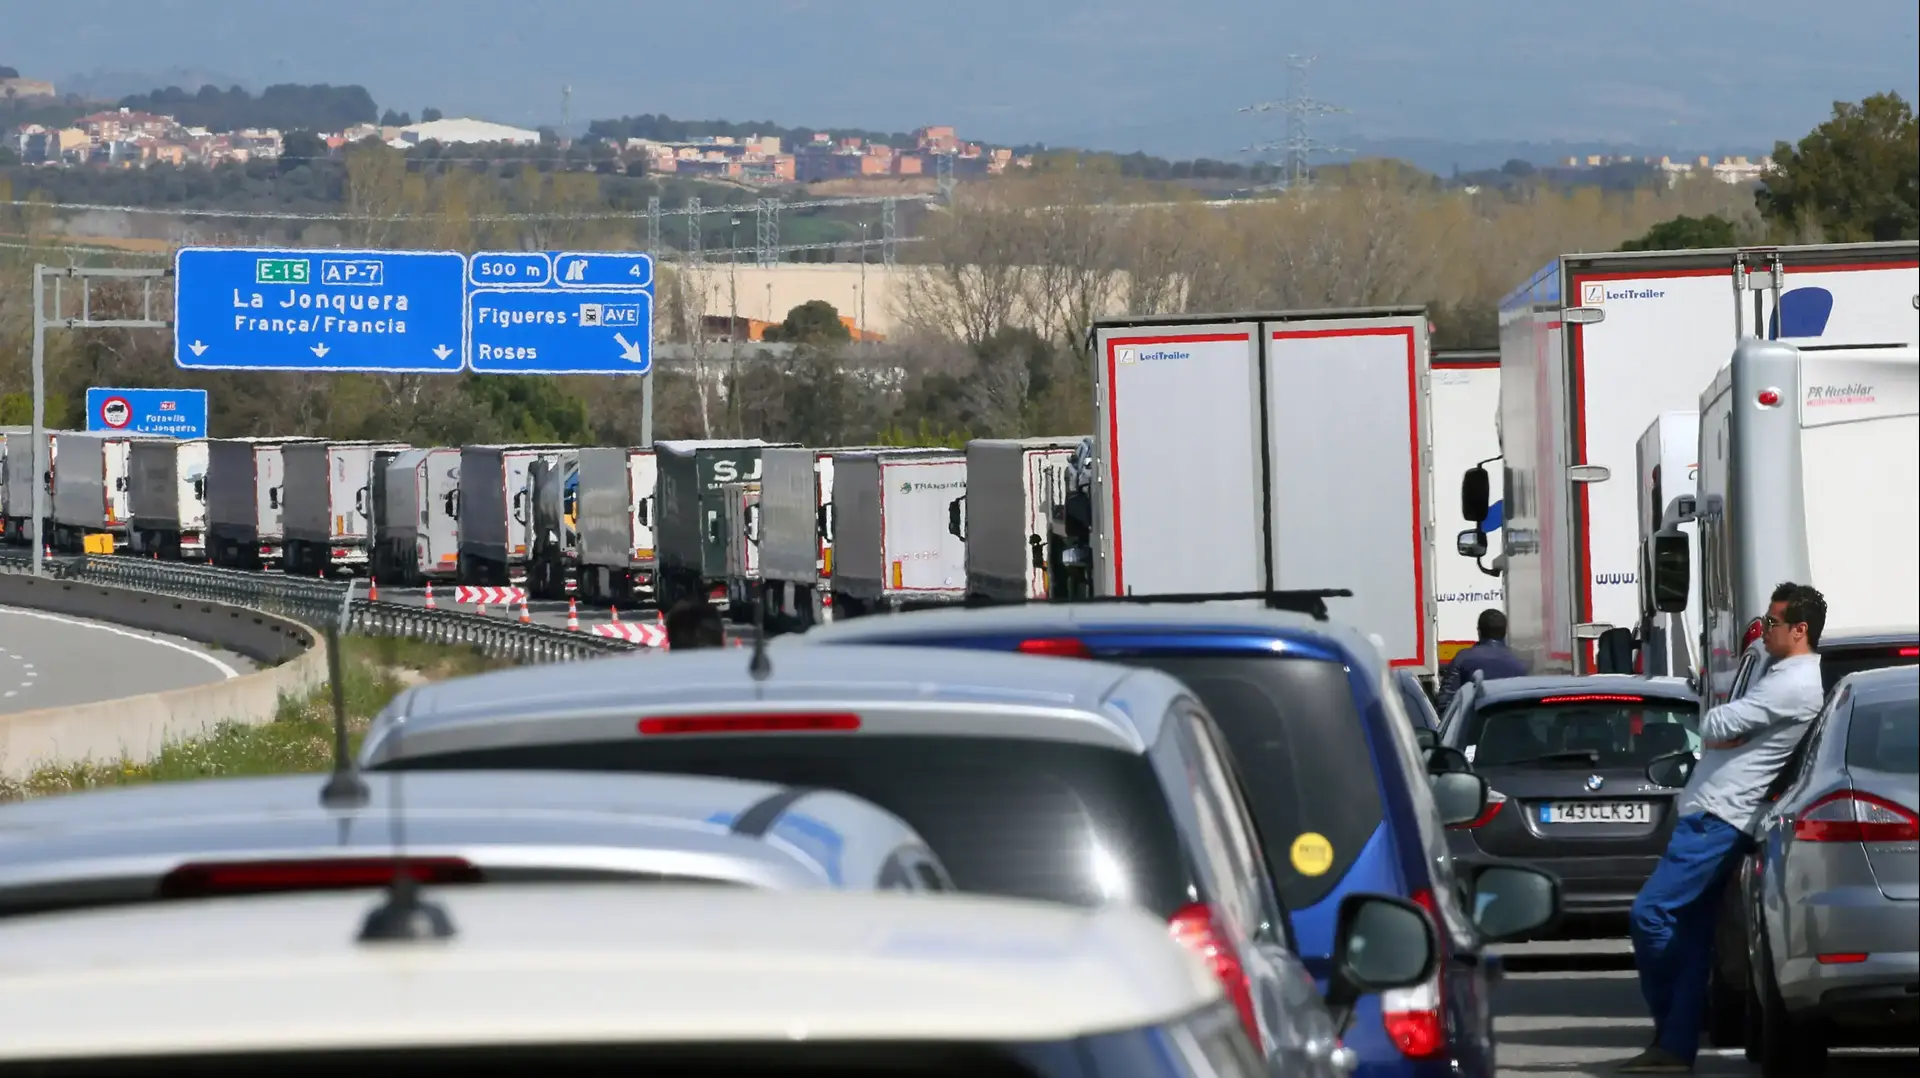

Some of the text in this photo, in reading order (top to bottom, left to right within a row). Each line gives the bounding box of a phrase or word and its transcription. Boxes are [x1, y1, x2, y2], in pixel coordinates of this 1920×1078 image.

[260, 263, 305, 280] E-15
[326, 264, 379, 281] AP-7
[481, 262, 541, 277] 500 m
[629, 264, 641, 278] 4
[233, 288, 409, 315] La Jonquera
[1606, 289, 1665, 300] LeciTrailer
[478, 307, 567, 328] Figueres
[604, 308, 636, 322] AVE
[235, 315, 406, 334] França/Francia
[479, 343, 537, 360] Roses
[1140, 352, 1190, 361] LeciTrailer
[1808, 386, 1824, 399] PR
[1557, 803, 1587, 820] 143
[1589, 804, 1622, 820] CLK
[1624, 804, 1645, 820] 31
